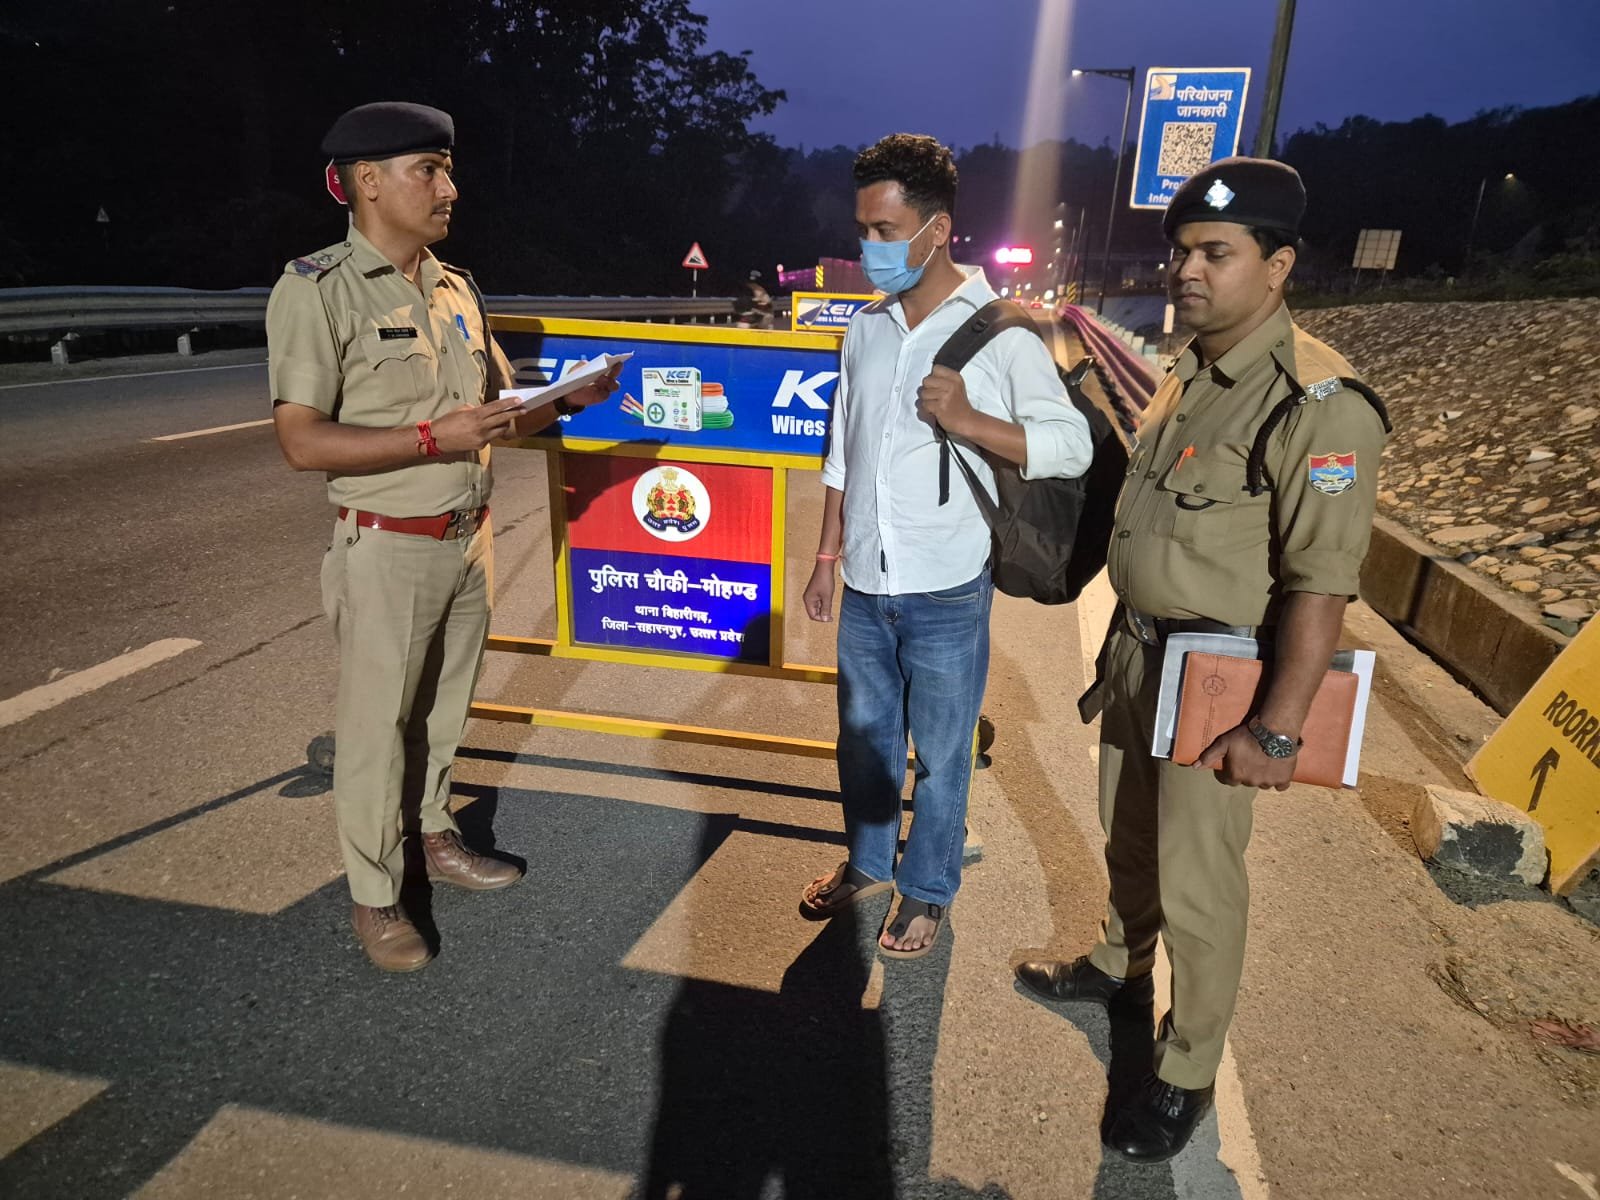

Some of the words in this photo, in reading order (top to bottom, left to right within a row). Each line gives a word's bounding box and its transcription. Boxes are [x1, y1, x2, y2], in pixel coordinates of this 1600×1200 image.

[1177, 86, 1233, 102] परियोजना
[1177, 102, 1227, 118] जानकारी
[334, 174, 340, 184] S
[1161, 178, 1184, 190] Pro
[666, 370, 691, 378] KEI
[771, 369, 840, 410] K
[771, 414, 826, 436] Wires
[588, 564, 639, 593] पुलिस
[635, 604, 659, 617] थाना
[1542, 690, 1600, 769] ROORK
